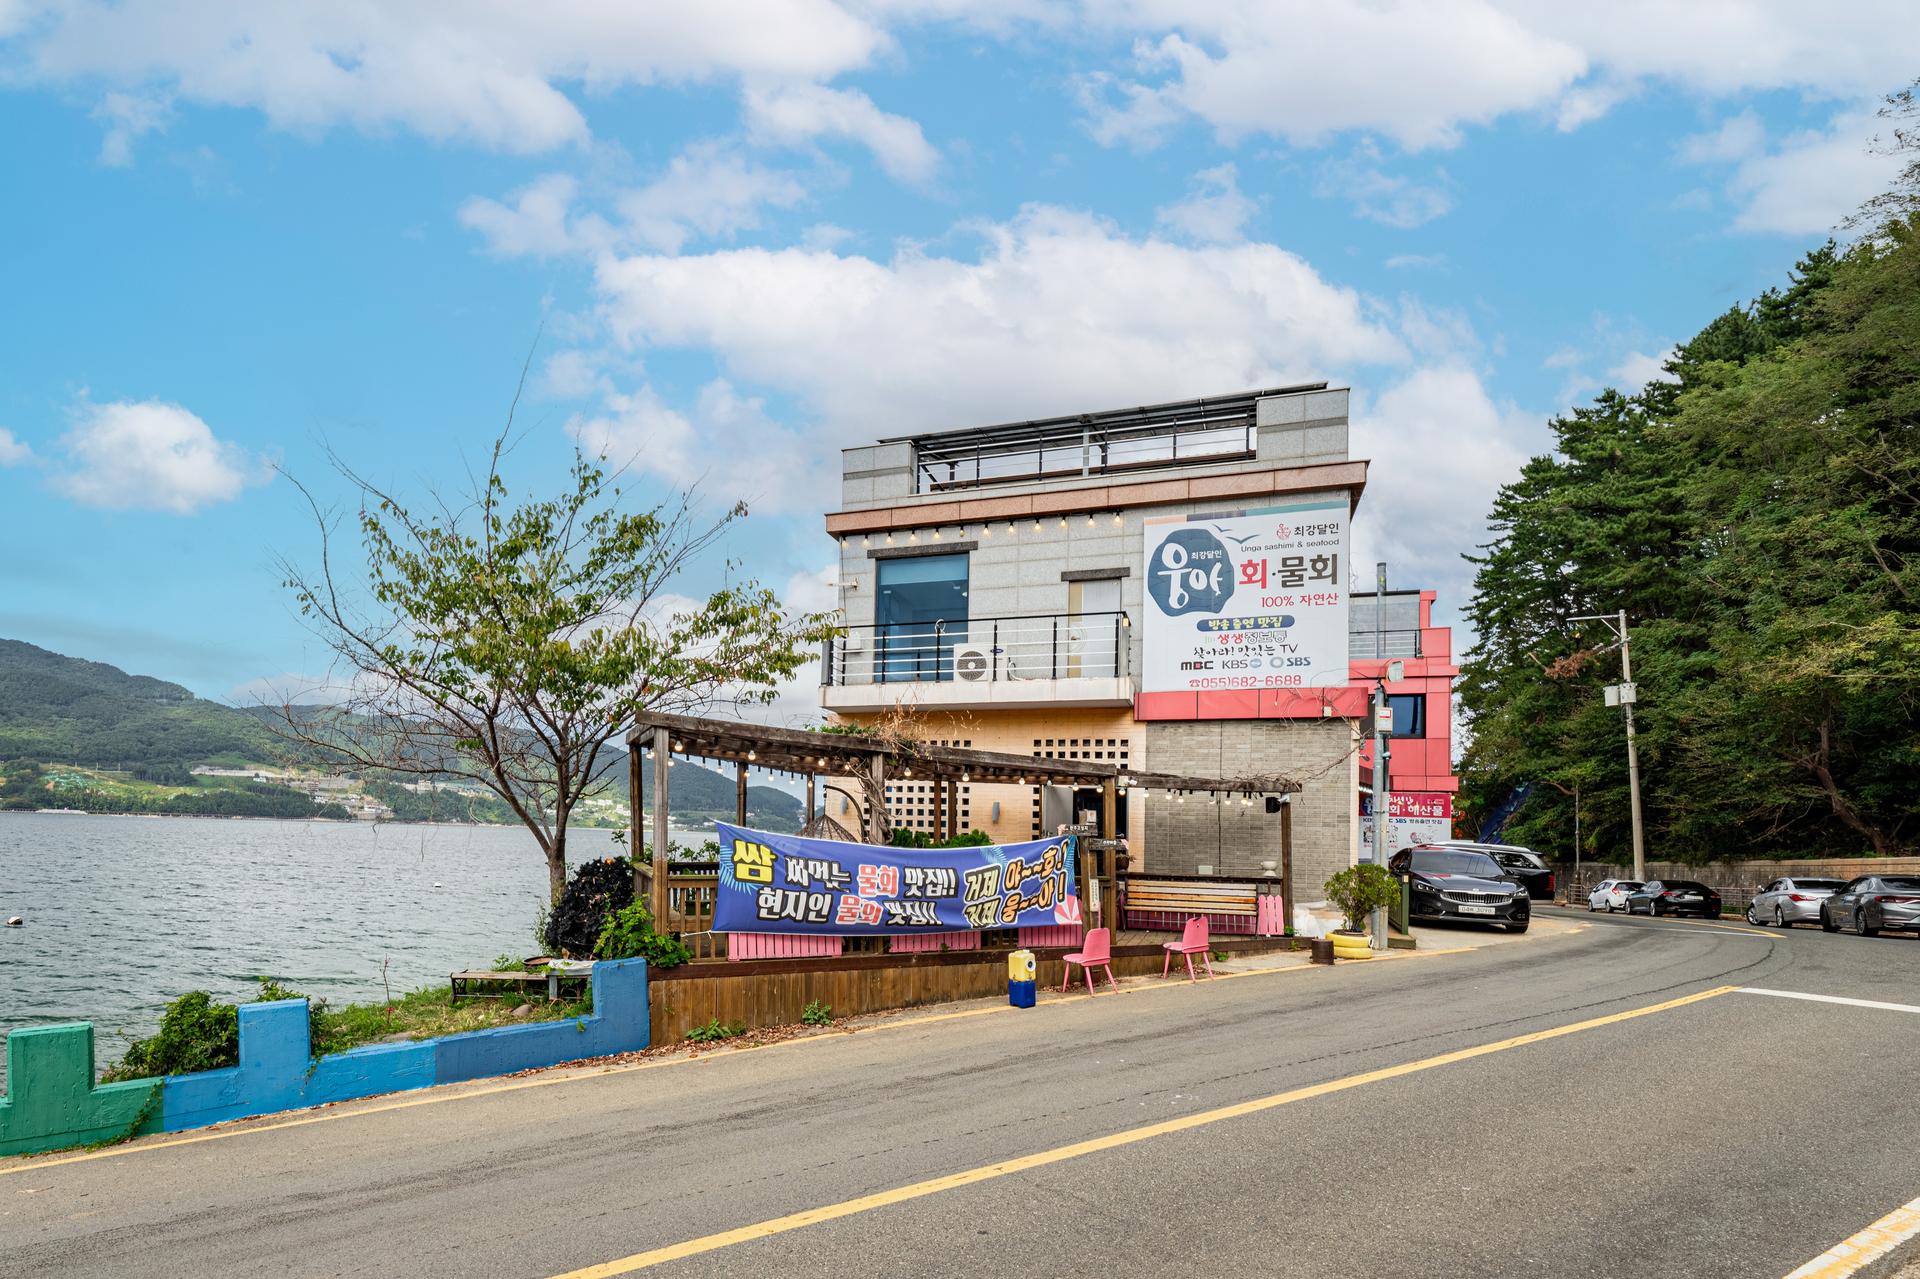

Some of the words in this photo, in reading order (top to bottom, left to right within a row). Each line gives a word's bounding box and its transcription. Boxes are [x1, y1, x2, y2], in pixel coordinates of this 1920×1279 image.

[1294, 522, 1339, 536] 최강달인
[1264, 542, 1294, 550] sashimi
[1306, 538, 1339, 547] seafood
[1191, 549, 1222, 560] 최강달인
[1261, 595, 1295, 608] 100%
[1299, 592, 1339, 606] 자연산
[1208, 619, 1230, 631] 방송
[1232, 617, 1255, 629] 출연
[1258, 615, 1282, 628] 맛집
[1193, 646, 1235, 659] 찾아라!
[1238, 644, 1275, 657] 맛있는
[1279, 644, 1298, 654] TV
[1222, 660, 1248, 669] KBS
[1286, 657, 1311, 667] SBS
[1201, 674, 1302, 688] 055)682-6688
[733, 839, 777, 883] 쌈
[858, 864, 898, 897] 물회
[904, 867, 956, 897] 맛집!!
[966, 868, 999, 901] 거제
[758, 886, 833, 922] 현지인
[836, 895, 883, 924] 물회
[883, 900, 943, 926] 맛집!!
[964, 898, 1000, 928] 거제
